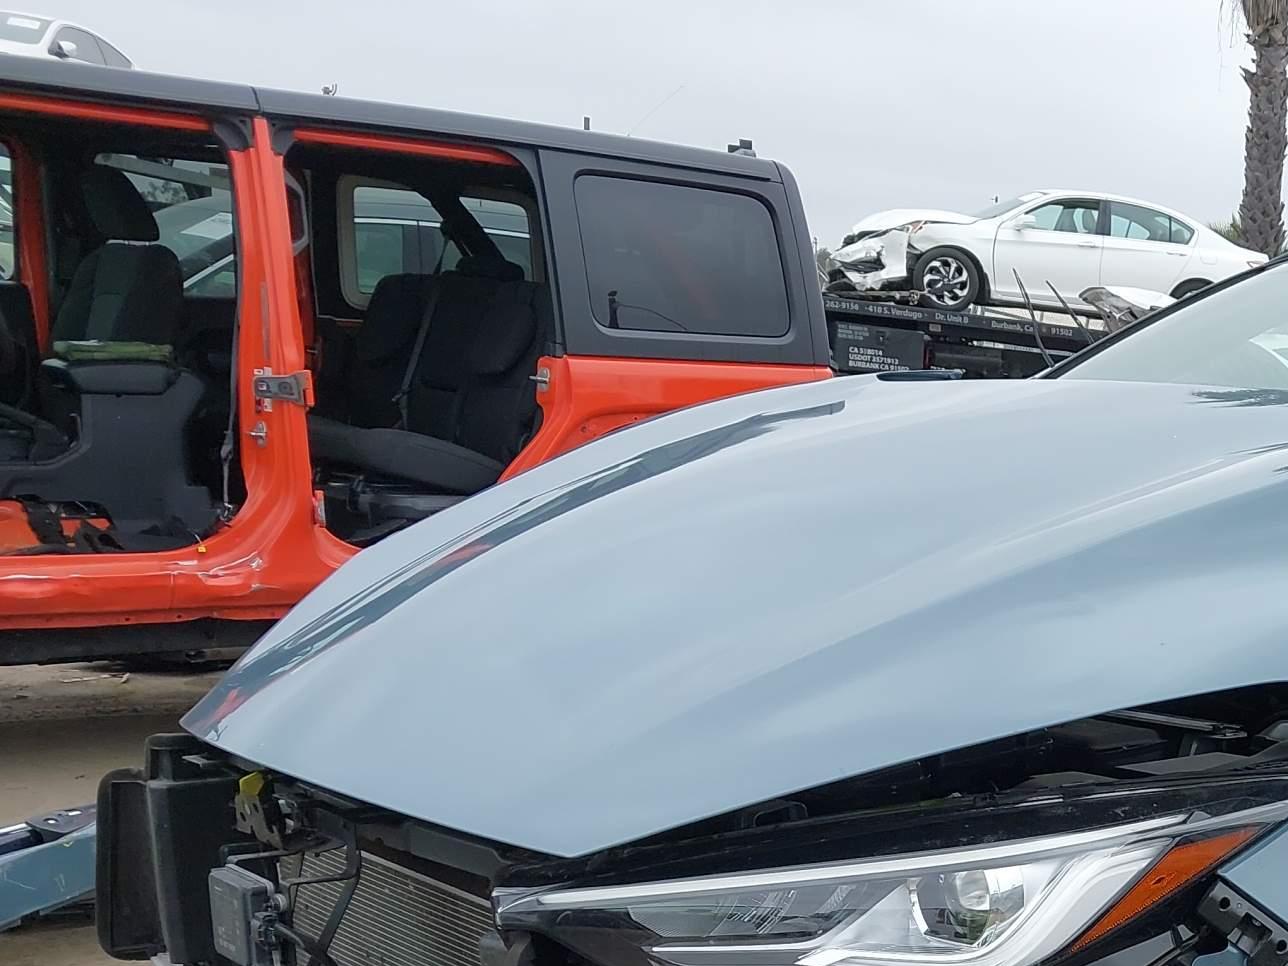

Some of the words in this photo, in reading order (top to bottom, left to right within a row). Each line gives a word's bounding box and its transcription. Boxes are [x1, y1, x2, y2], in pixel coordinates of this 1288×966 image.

[891, 307, 923, 320] Verdugo
[935, 312, 946, 321] Dr.
[947, 313, 962, 323] Unit
[991, 320, 1023, 332] Burbank,
[1051, 327, 1073, 337] 91502
[848, 346, 858, 354] CA
[848, 353, 871, 362] USDOT
[848, 360, 879, 370] BURBANK
